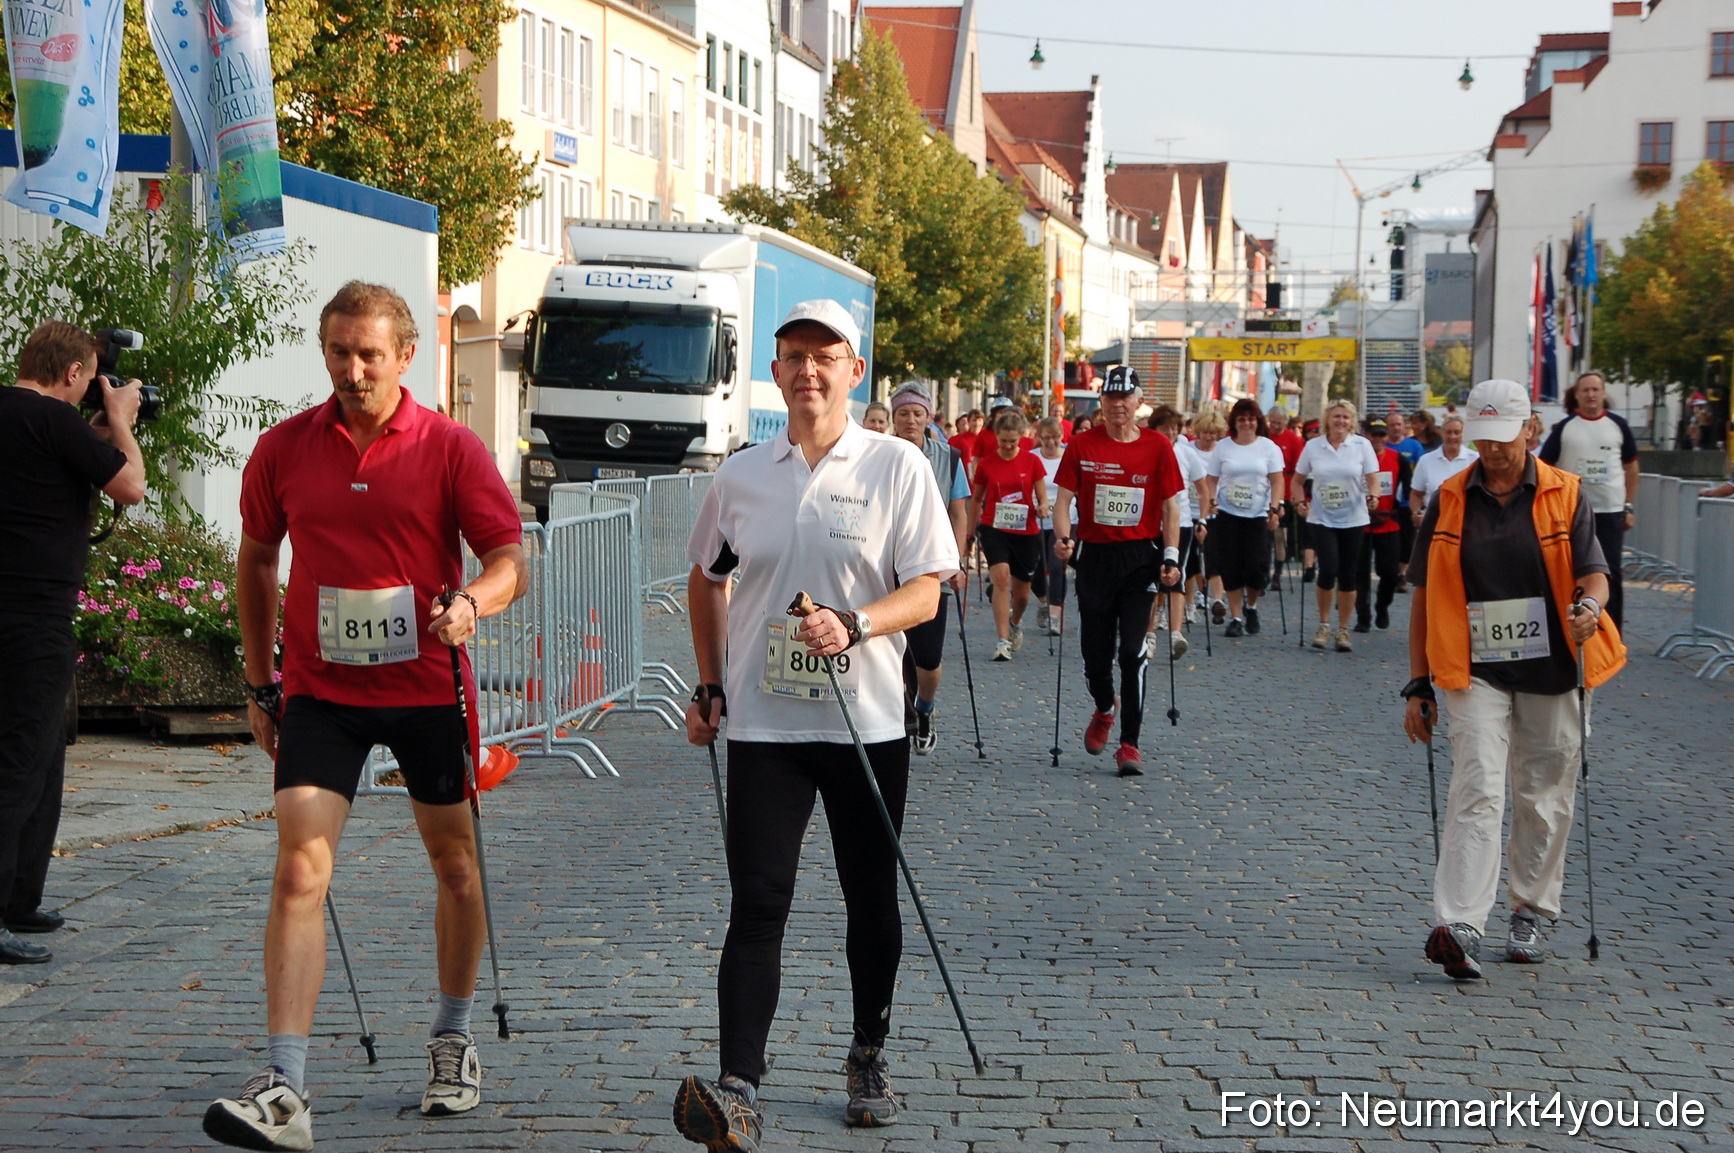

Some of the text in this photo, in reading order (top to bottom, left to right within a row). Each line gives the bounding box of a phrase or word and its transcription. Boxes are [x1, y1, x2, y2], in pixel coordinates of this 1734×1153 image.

[585, 271, 674, 290] BOCK
[1242, 342, 1300, 357] START
[1108, 489, 1127, 498] Horst
[1329, 491, 1349, 500] 8031
[830, 494, 869, 507] Walking
[1107, 501, 1139, 514] 8070
[1004, 512, 1025, 522] 8015
[829, 531, 867, 543] Dilsberg
[322, 615, 329, 627] N
[345, 616, 408, 639] 8113
[1472, 625, 1479, 633] N
[1491, 621, 1541, 640] 8122
[769, 645, 776, 657] N
